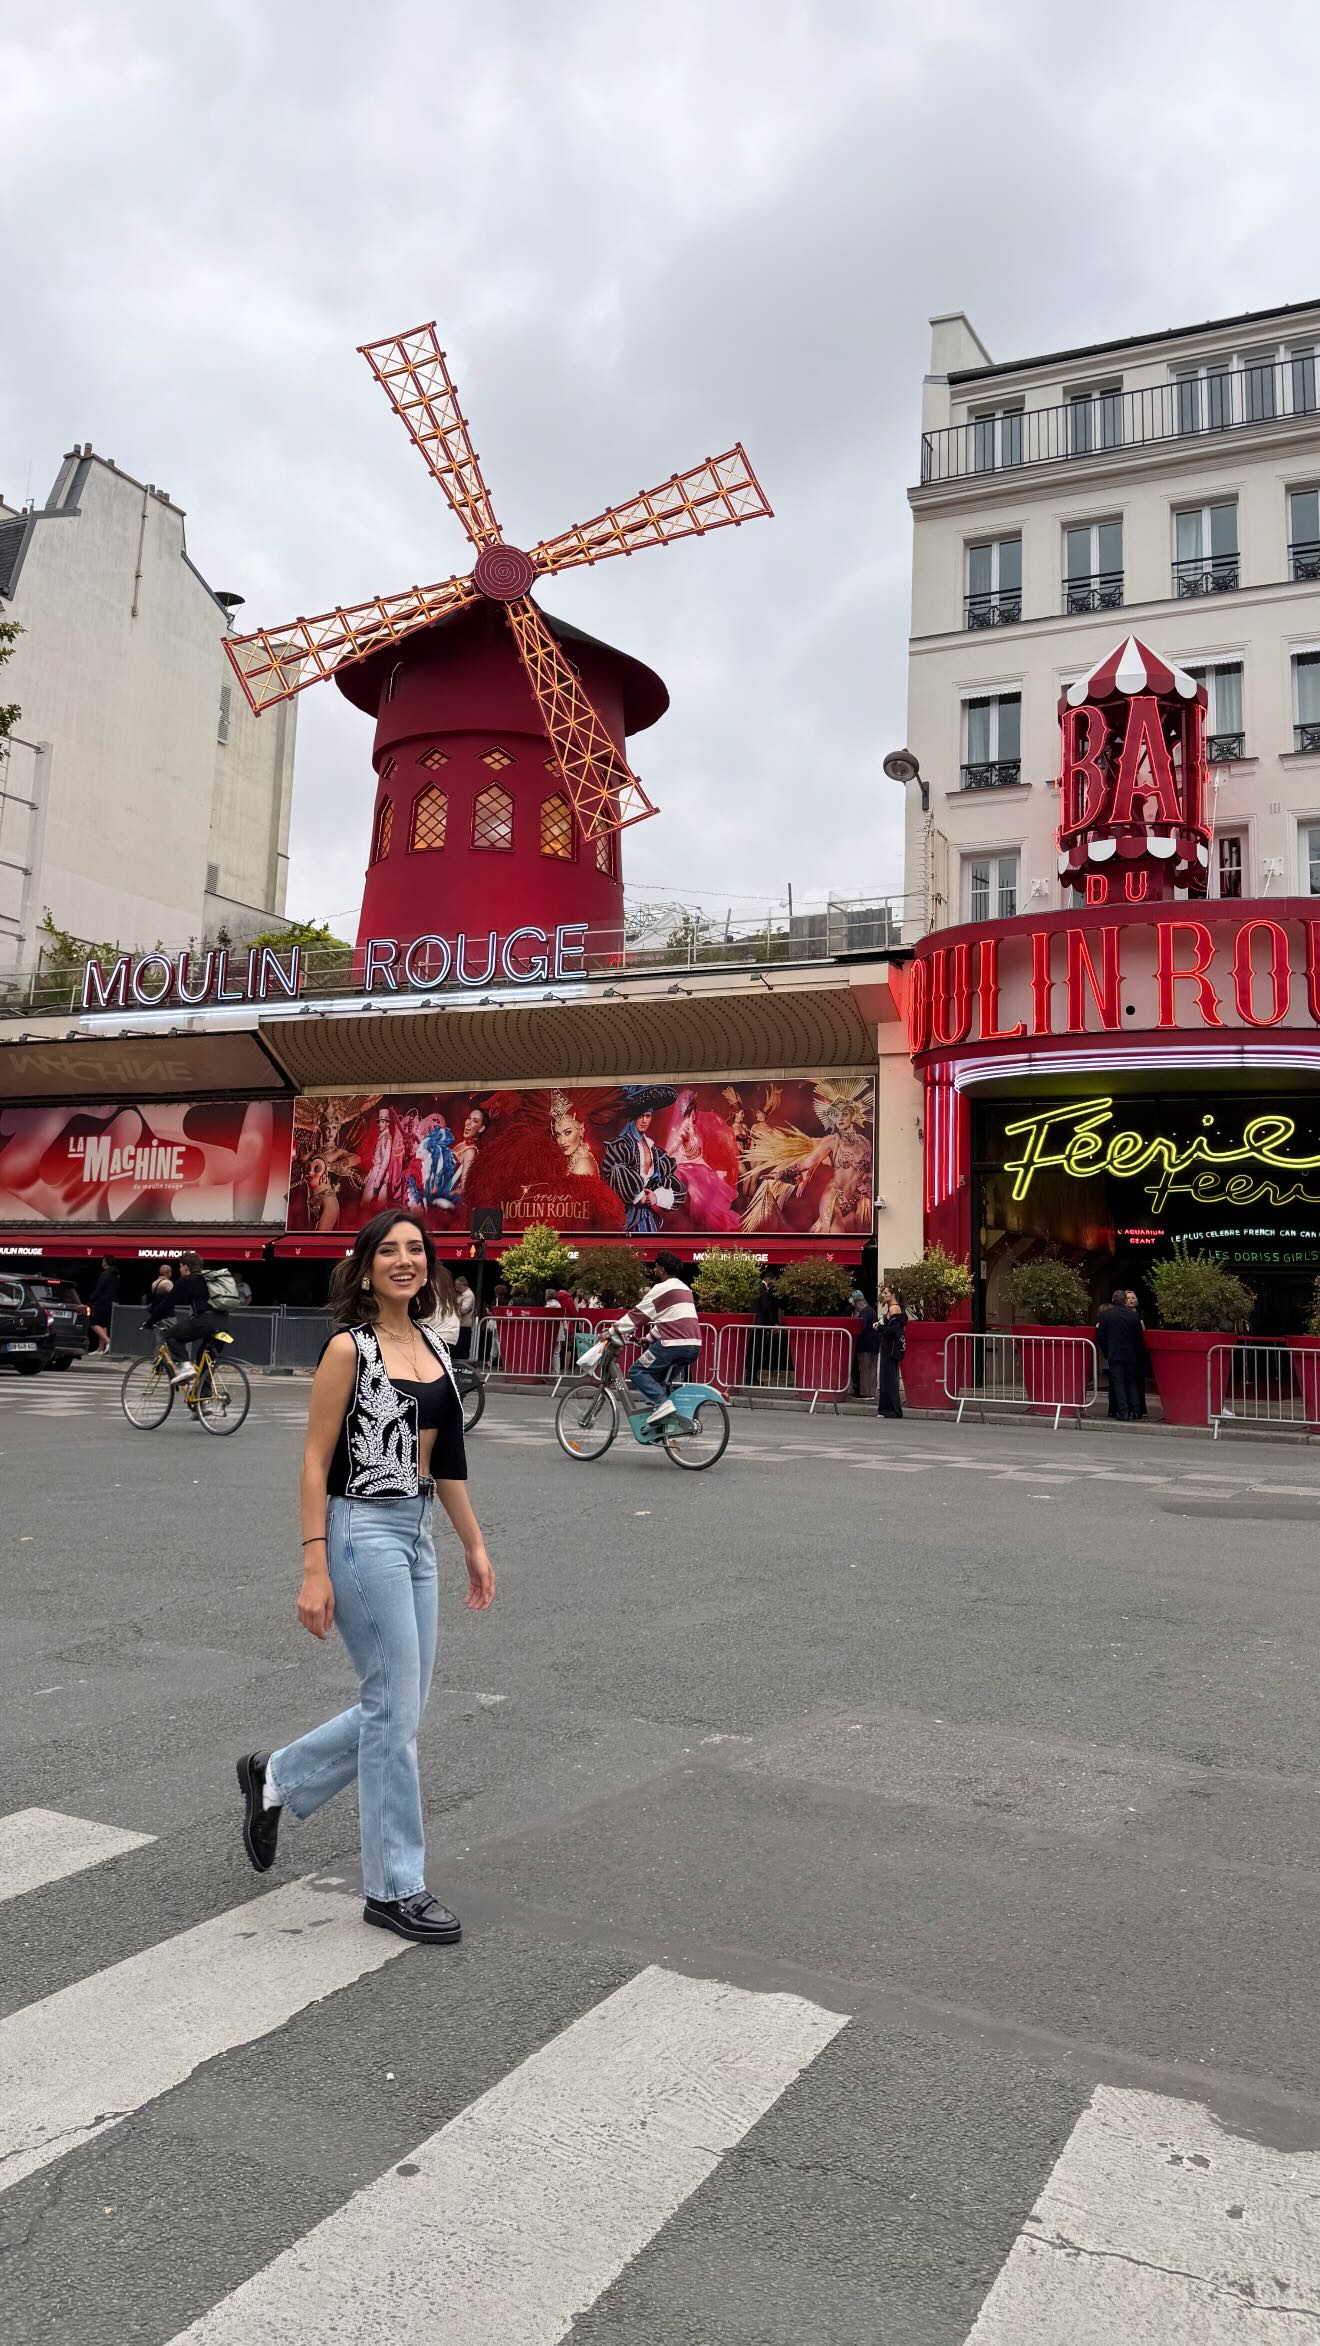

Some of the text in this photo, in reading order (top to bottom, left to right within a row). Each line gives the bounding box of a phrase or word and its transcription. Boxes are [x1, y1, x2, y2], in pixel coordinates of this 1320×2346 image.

[1086, 871, 1148, 905] DU
[82, 923, 589, 1008] MOULIN ROUGE
[1152, 919, 1320, 1028] RO
[69, 1136, 85, 1153] LA
[1004, 1097, 1320, 1202] Féerie
[520, 1182, 574, 1203] Forever
[500, 1200, 590, 1220] MOULIN ROUGE
[1182, 1231, 1204, 1241] PLUS
[1243, 1228, 1276, 1236] FRENCH
[1279, 1229, 1297, 1237] CAN
[1300, 1230, 1317, 1238] CAN
[18, 1247, 43, 1256] ROUGE
[138, 1249, 168, 1258] MOULIN
[1208, 1248, 1230, 1260] LES
[1234, 1252, 1280, 1262] DORISS
